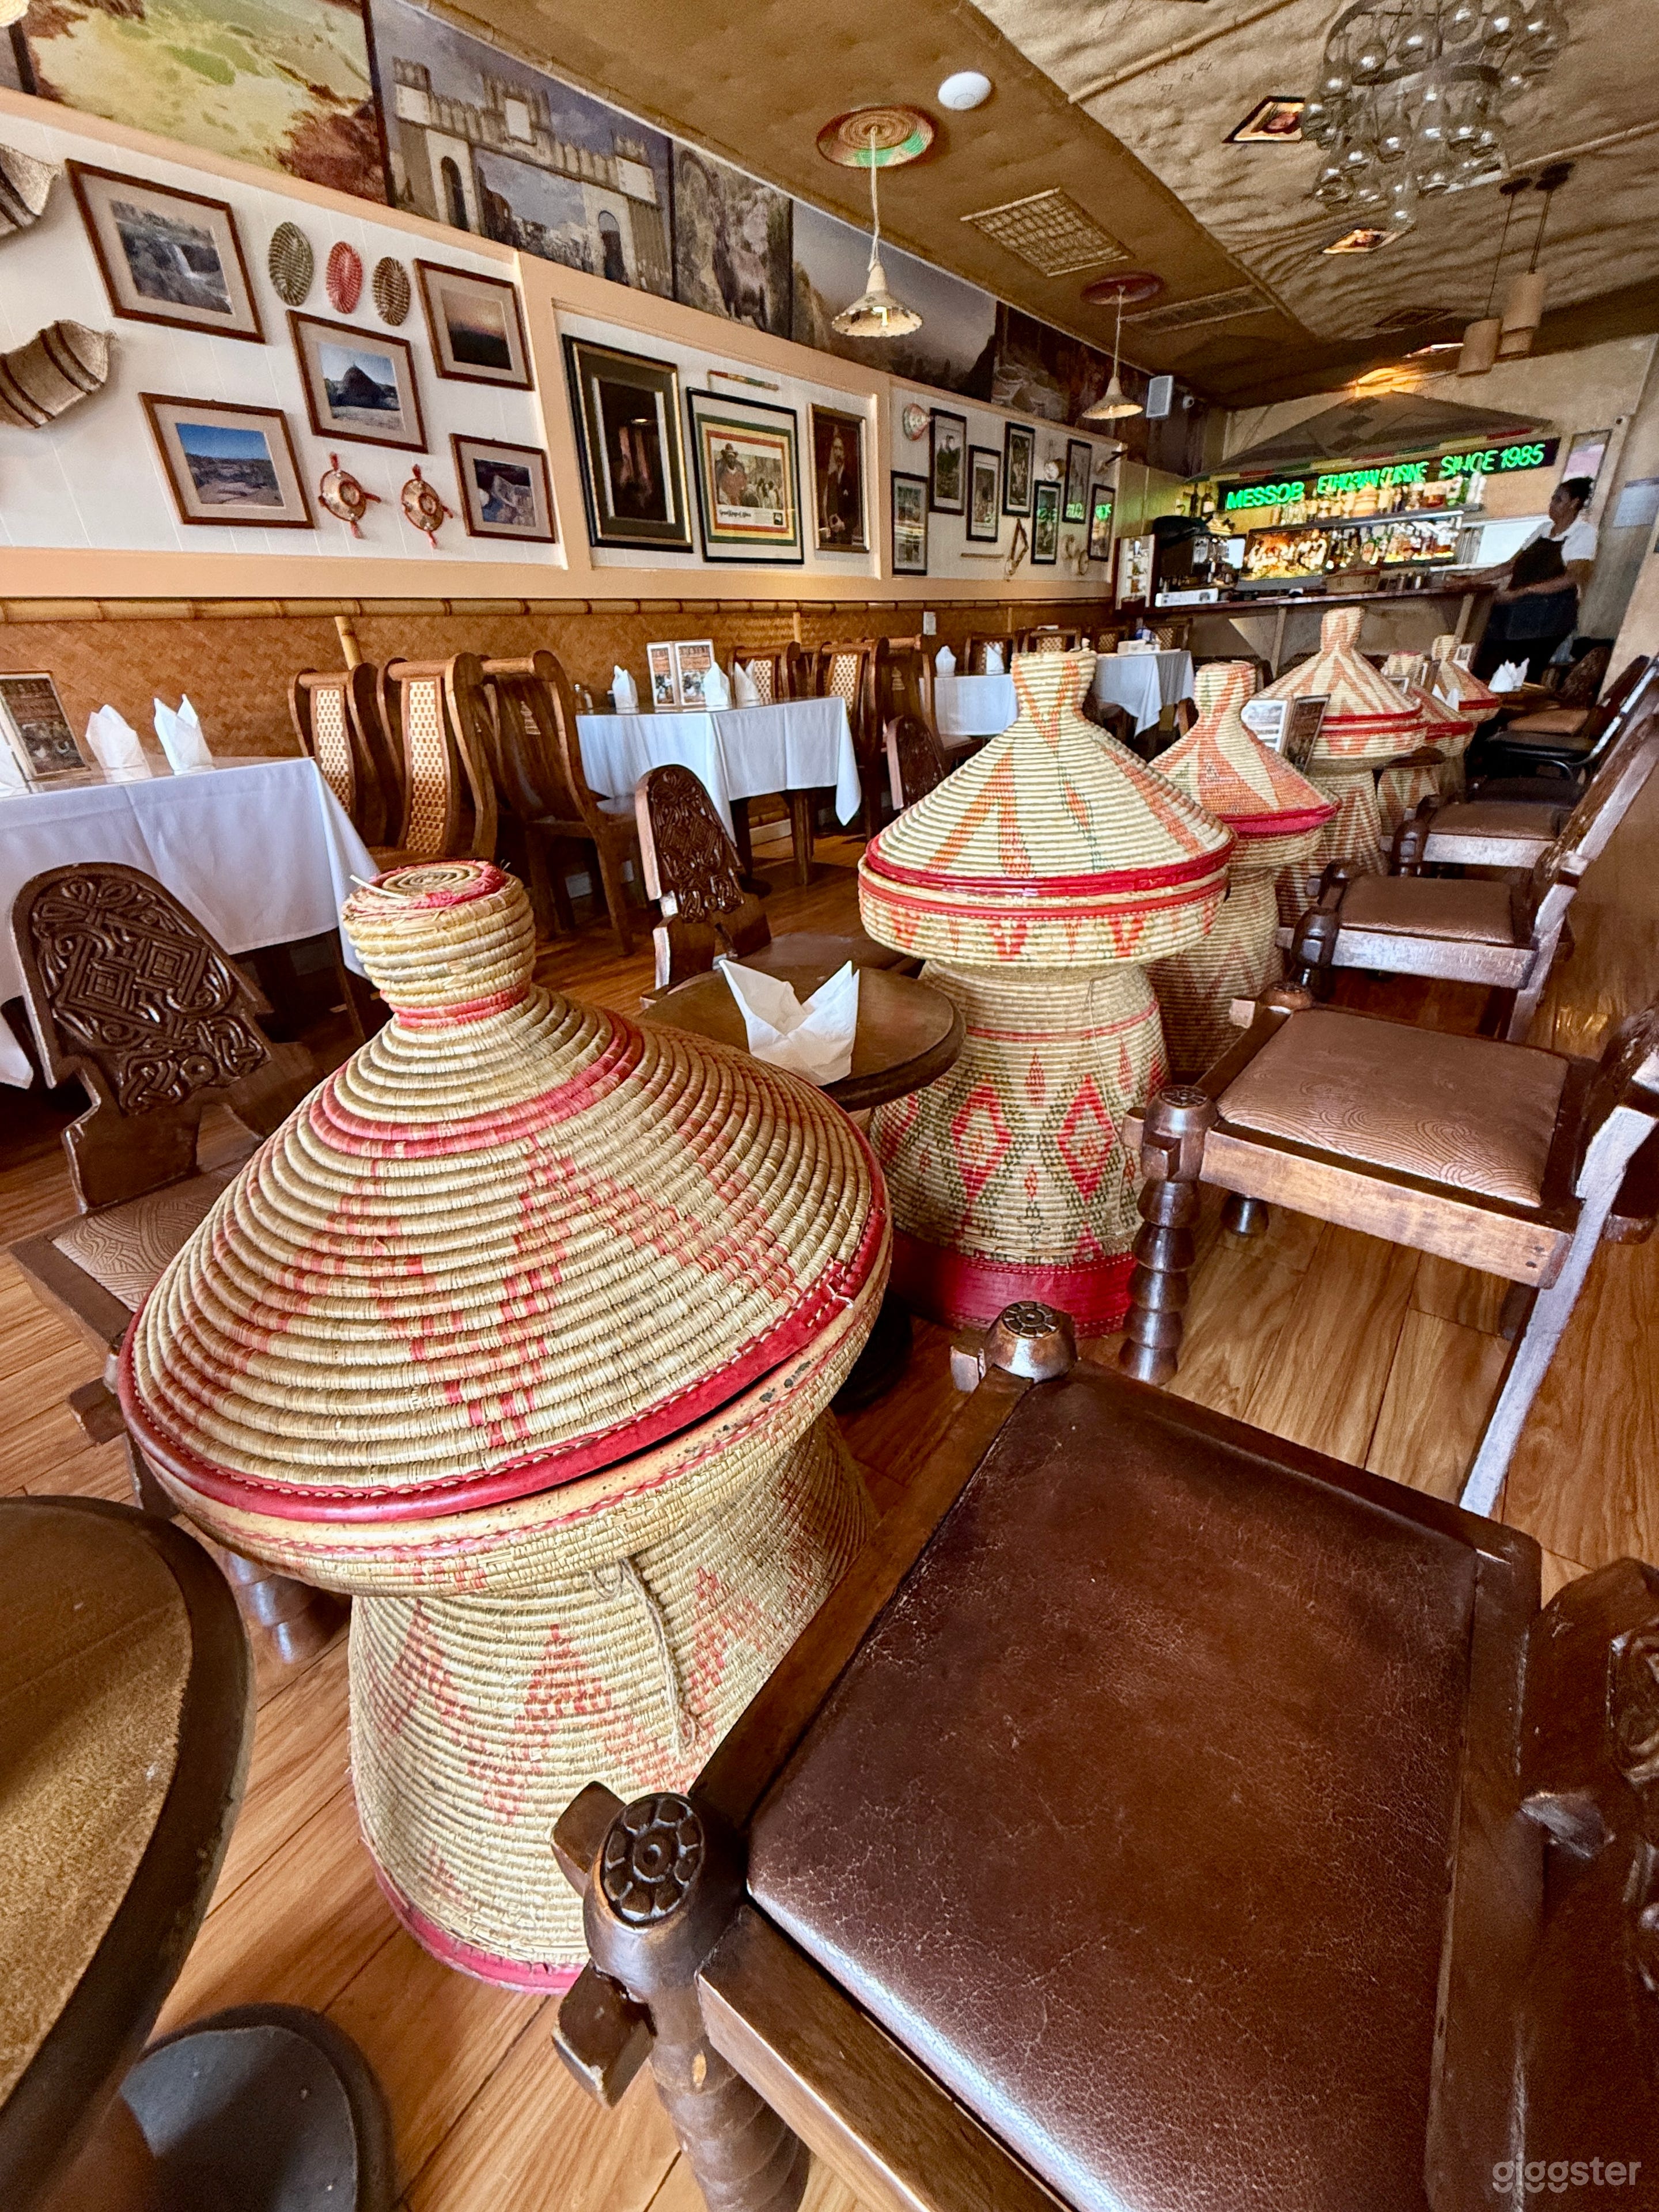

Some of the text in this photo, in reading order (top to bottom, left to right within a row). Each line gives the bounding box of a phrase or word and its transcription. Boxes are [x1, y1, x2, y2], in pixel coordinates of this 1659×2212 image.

[1226, 482, 1305, 509] MESSOB
[1440, 450, 1498, 478] SINCE
[1500, 444, 1546, 468] 1985
